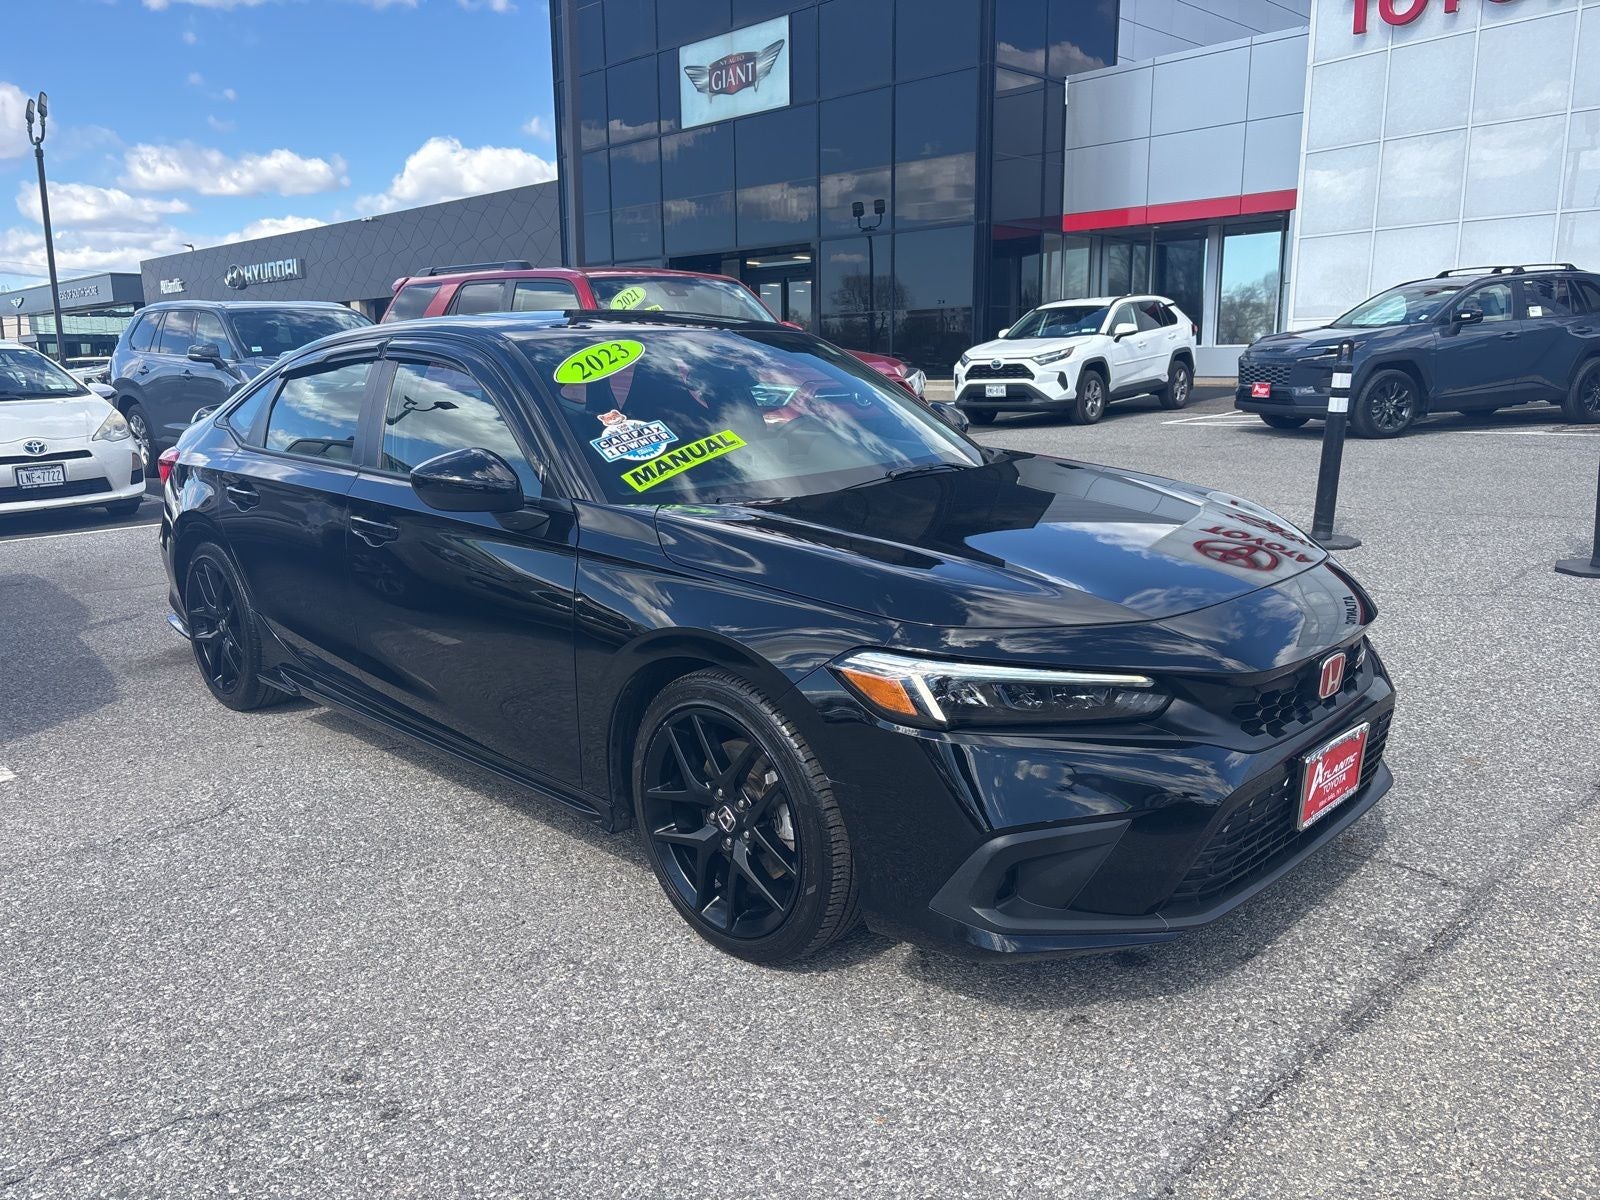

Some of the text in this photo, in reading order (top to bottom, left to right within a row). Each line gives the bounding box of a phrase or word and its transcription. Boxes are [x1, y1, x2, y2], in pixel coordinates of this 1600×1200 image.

[711, 61, 754, 91] GIANT
[244, 258, 298, 283] HYUNDAI
[616, 289, 640, 310] 2021
[571, 343, 630, 380] 2023
[599, 425, 663, 449] CARFAX
[607, 449, 616, 457] 1
[618, 432, 671, 453] OWNER
[630, 434, 737, 487] MANUAL
[1323, 772, 1347, 795] TOYOTA
